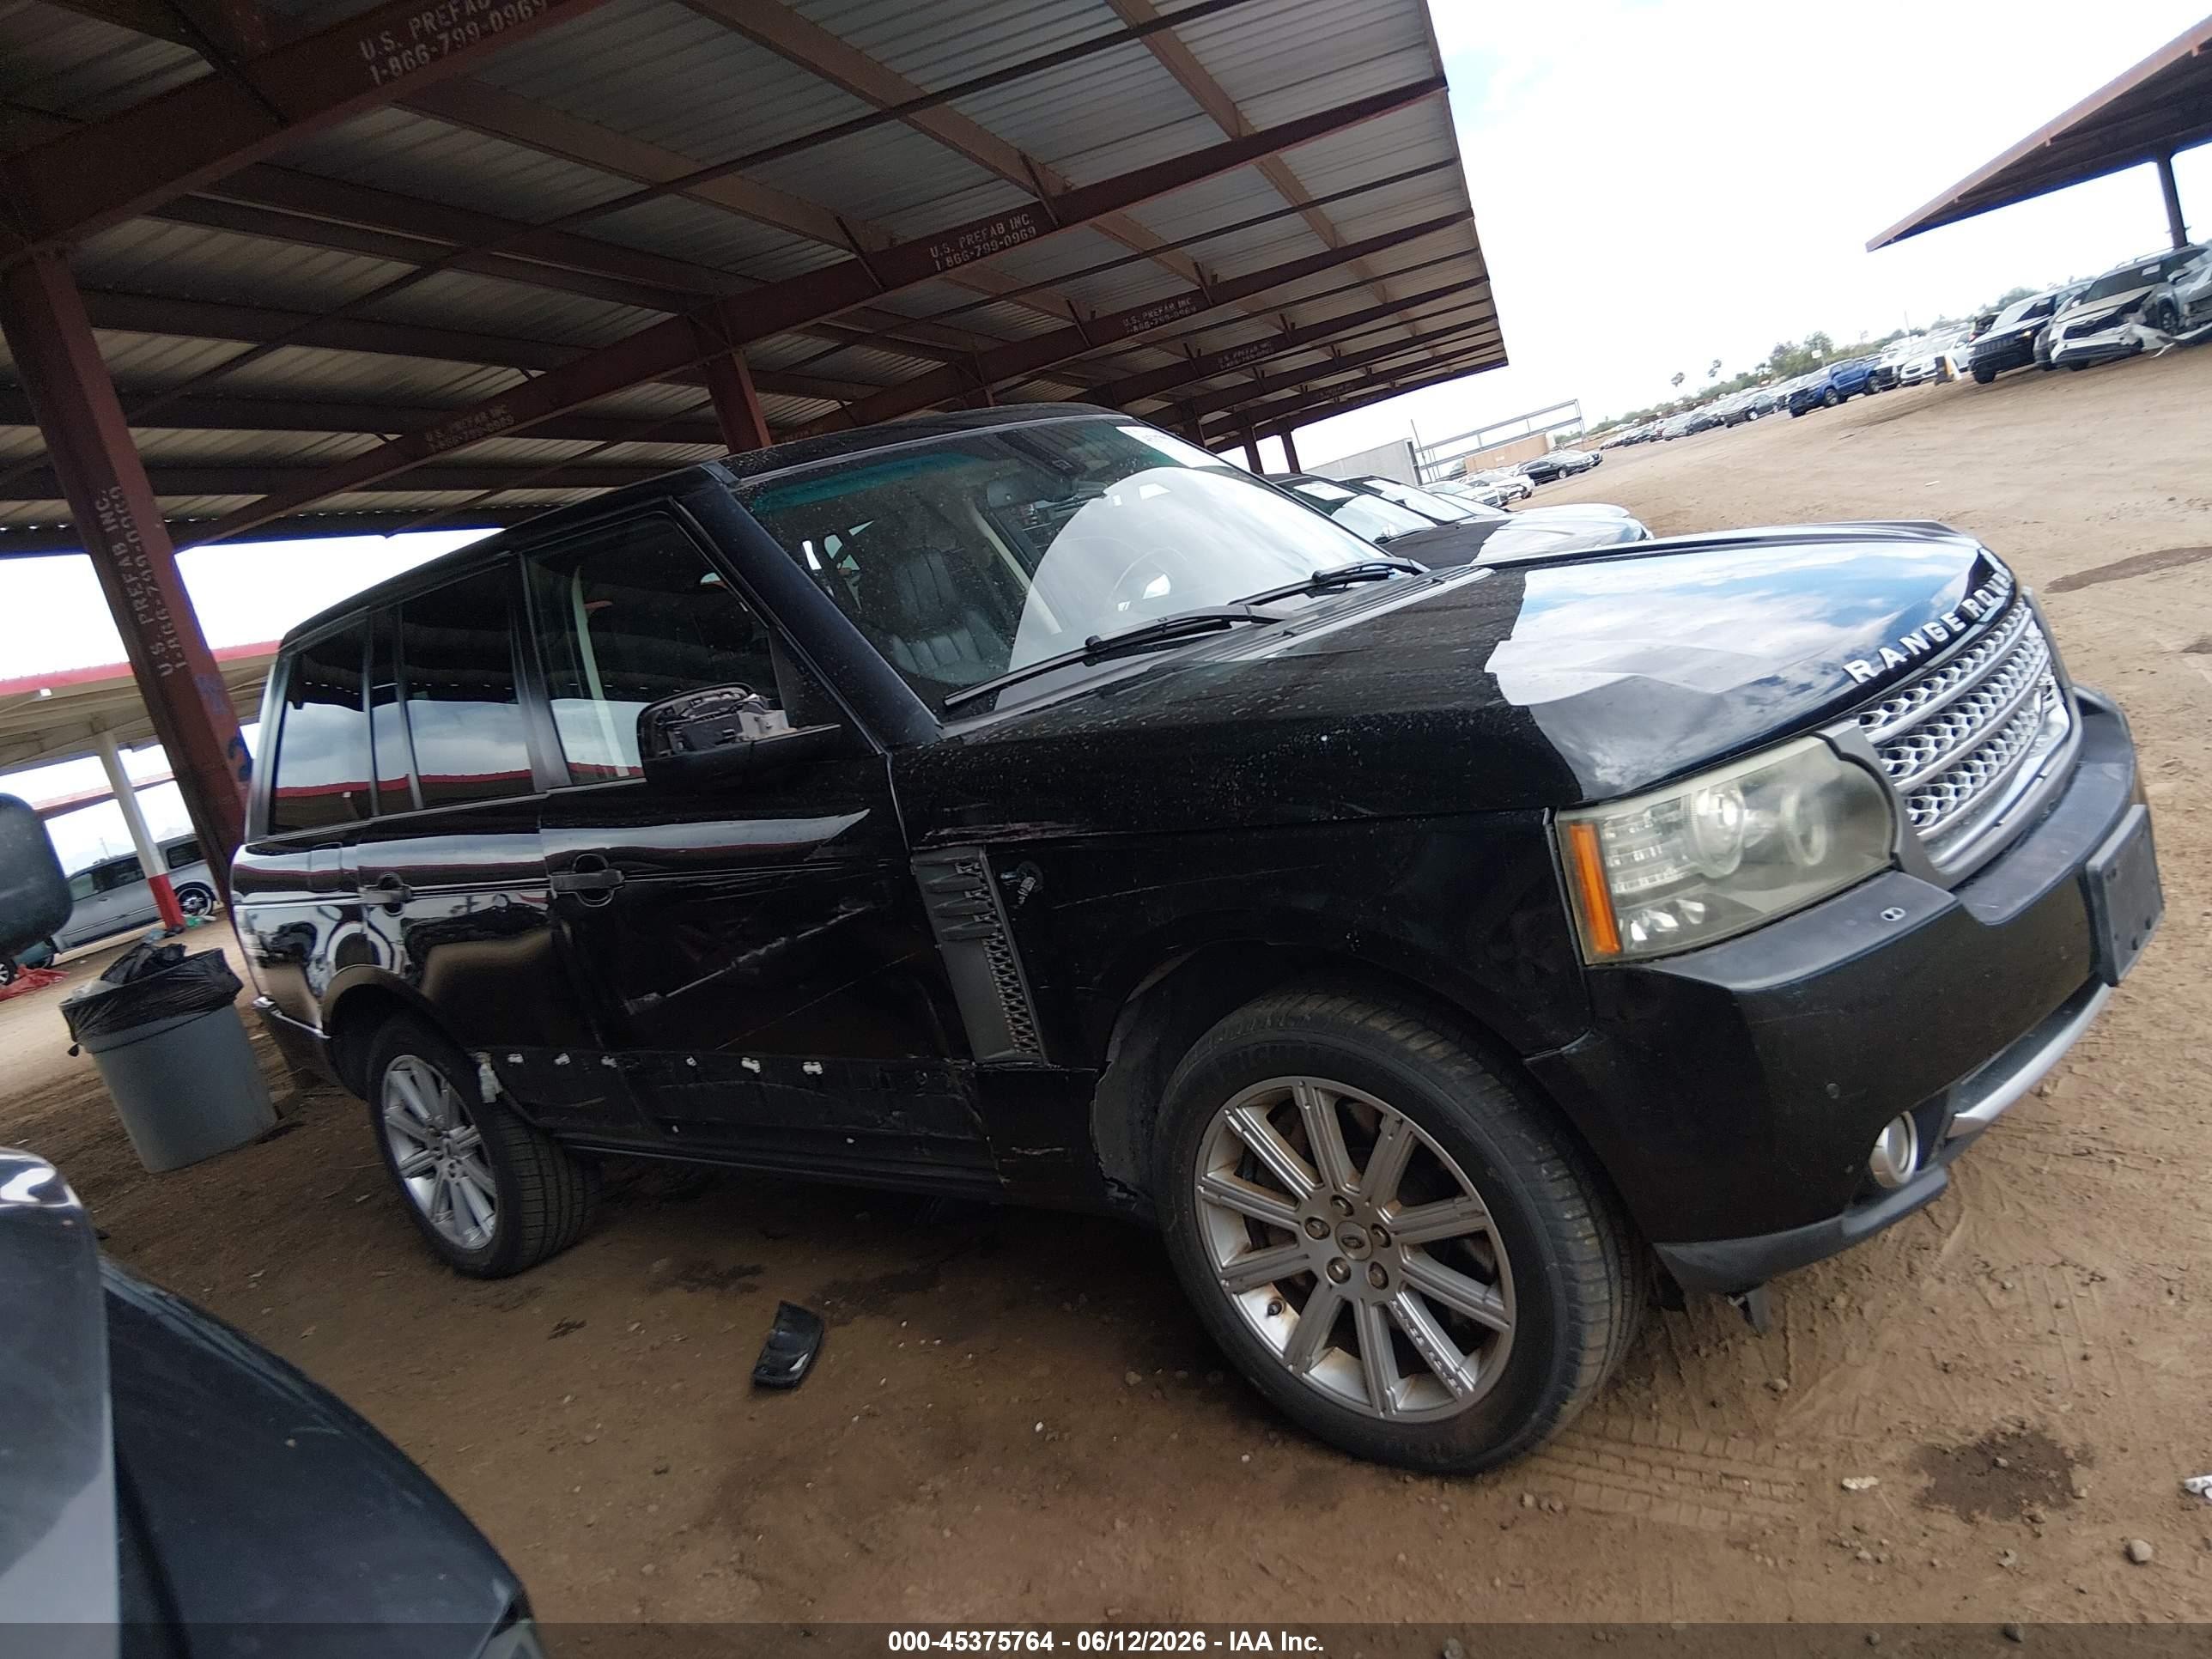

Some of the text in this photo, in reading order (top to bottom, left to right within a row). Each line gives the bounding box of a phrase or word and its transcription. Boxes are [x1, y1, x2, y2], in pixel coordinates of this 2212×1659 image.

[359, 29, 404, 61] U.S.
[929, 243, 955, 258] U.S.
[959, 222, 1006, 249] PREFAB
[111, 542, 155, 625] PREFAB
[1843, 611, 1966, 684] RANGE
